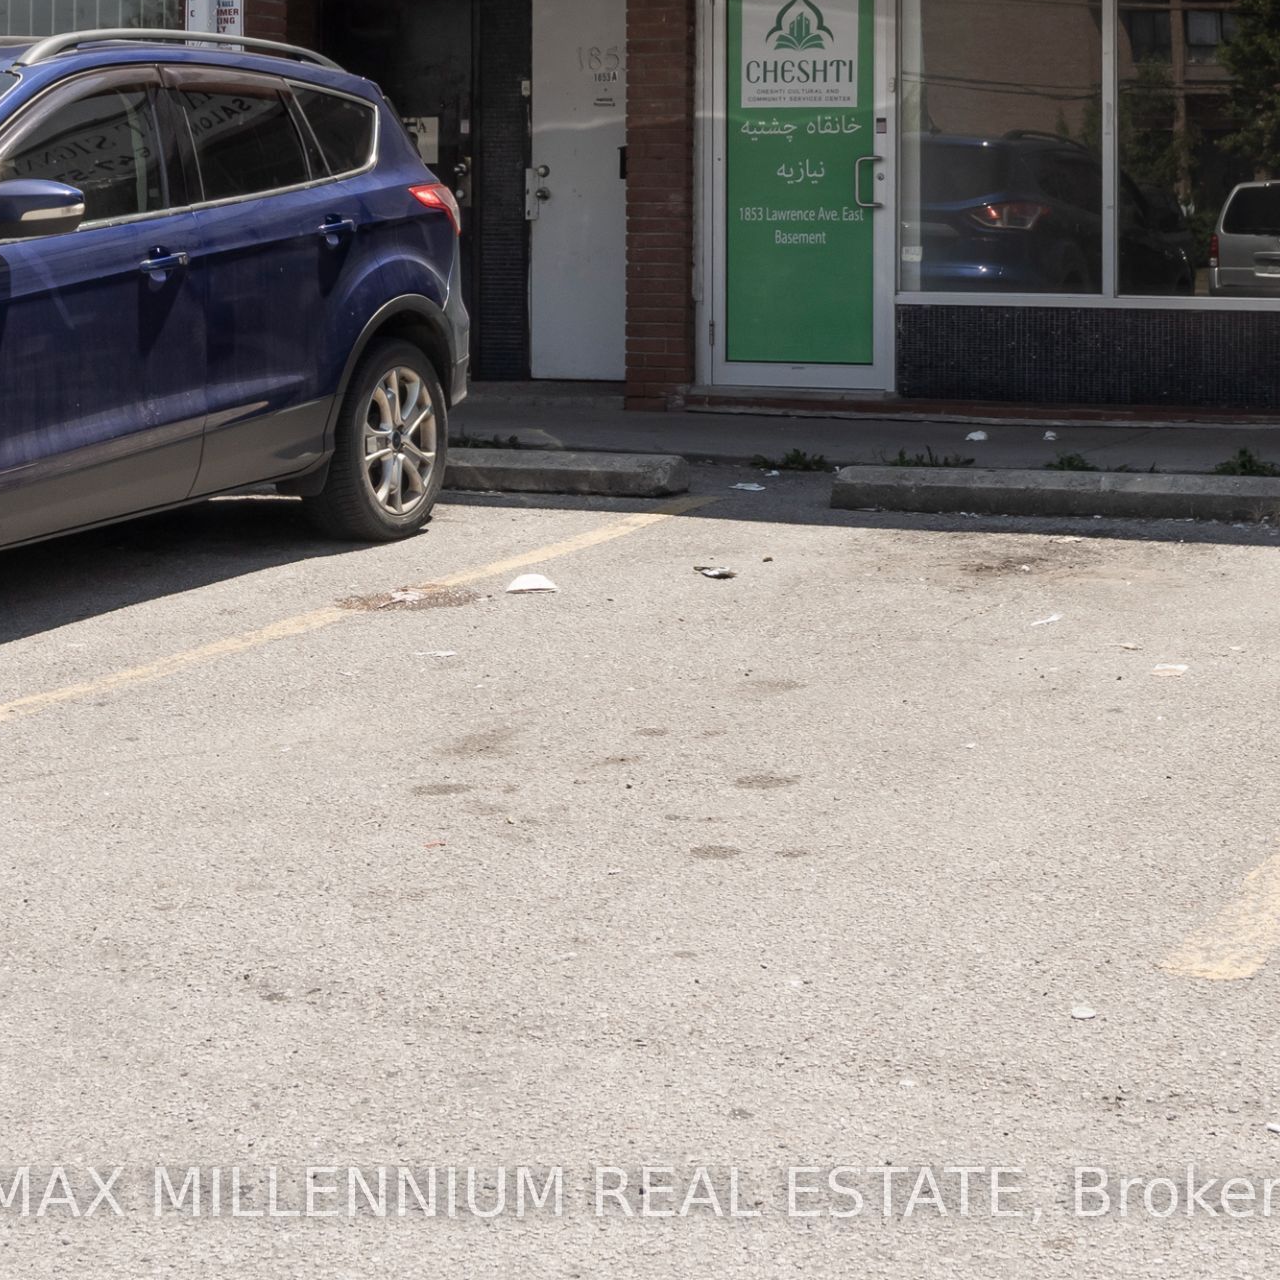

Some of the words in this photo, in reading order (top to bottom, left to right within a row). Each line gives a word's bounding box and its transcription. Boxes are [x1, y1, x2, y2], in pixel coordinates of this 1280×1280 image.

[746, 60, 853, 83] CHESHTI
[740, 207, 763, 221] 1853
[766, 207, 815, 221] Lawrence
[842, 207, 864, 221] East
[775, 230, 826, 244] Basement
